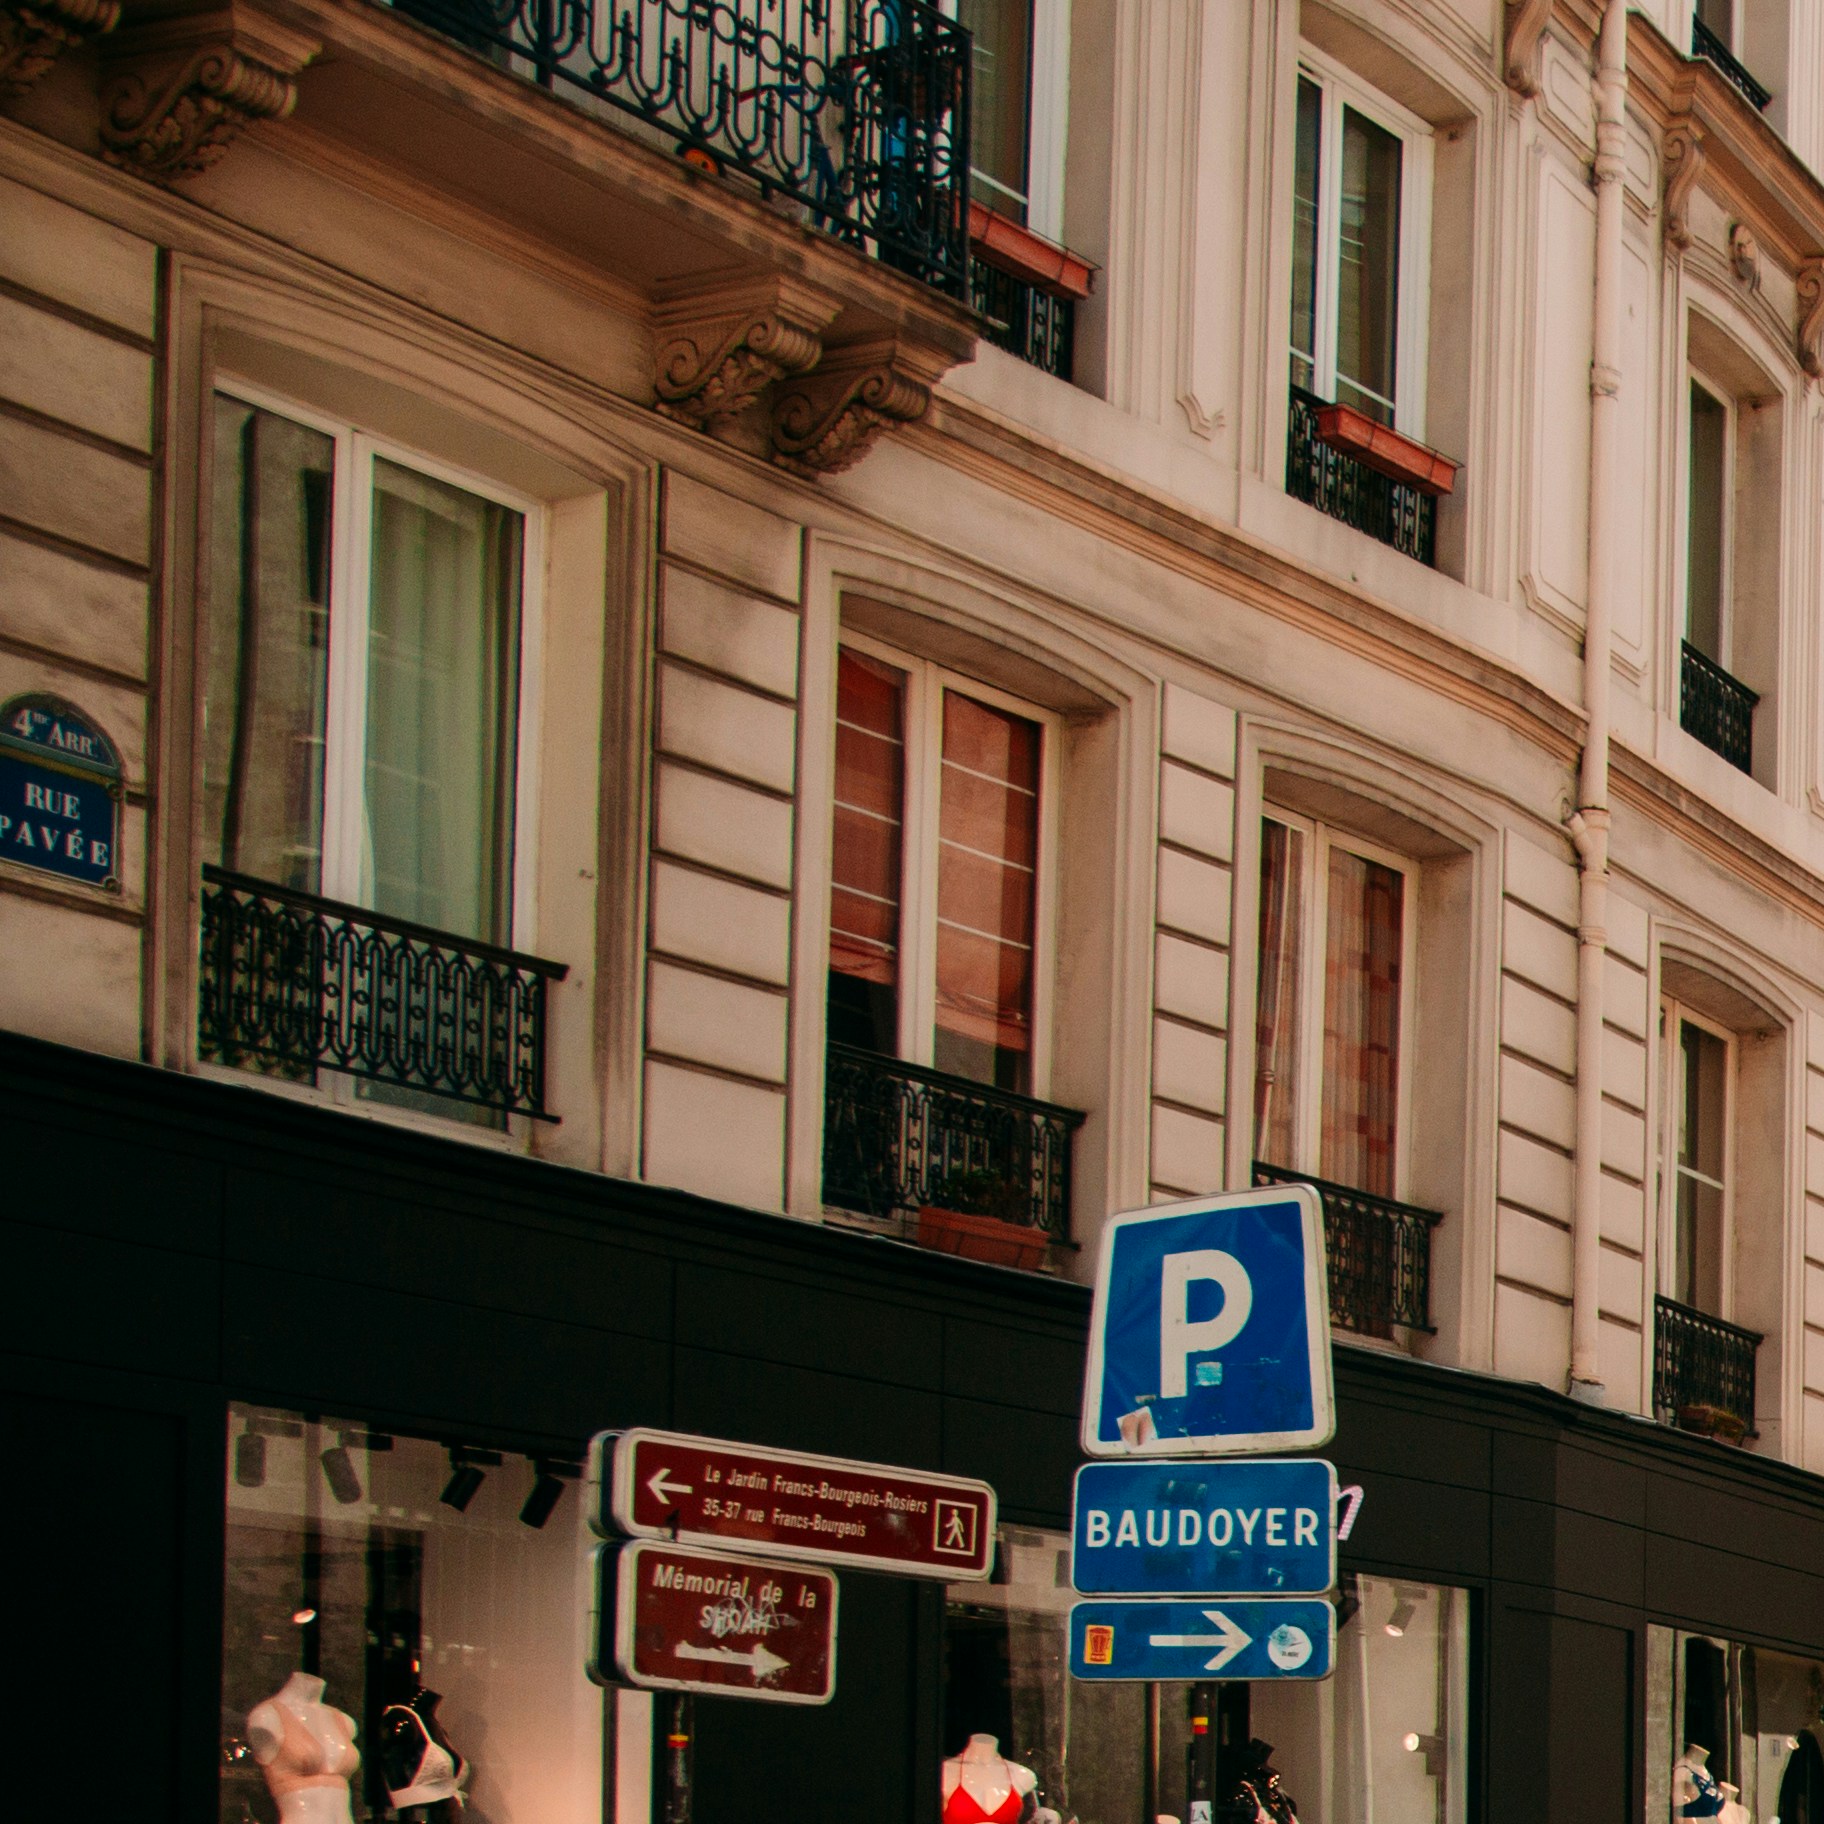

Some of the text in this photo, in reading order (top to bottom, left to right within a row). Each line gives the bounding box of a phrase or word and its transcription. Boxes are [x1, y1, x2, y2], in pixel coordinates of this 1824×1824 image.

[25, 782, 81, 820] RUE
[0, 814, 109, 867] PAVÉE
[1160, 1249, 1253, 1399] P
[705, 1464, 929, 1514] Le Jardin Francs-Bourgeois-Rosiers
[702, 1498, 867, 1538] 35-37 rue Francs-Bourgeois
[1085, 1507, 1319, 1548] BAUDOYER
[652, 1563, 817, 1609] Mémorial de la
